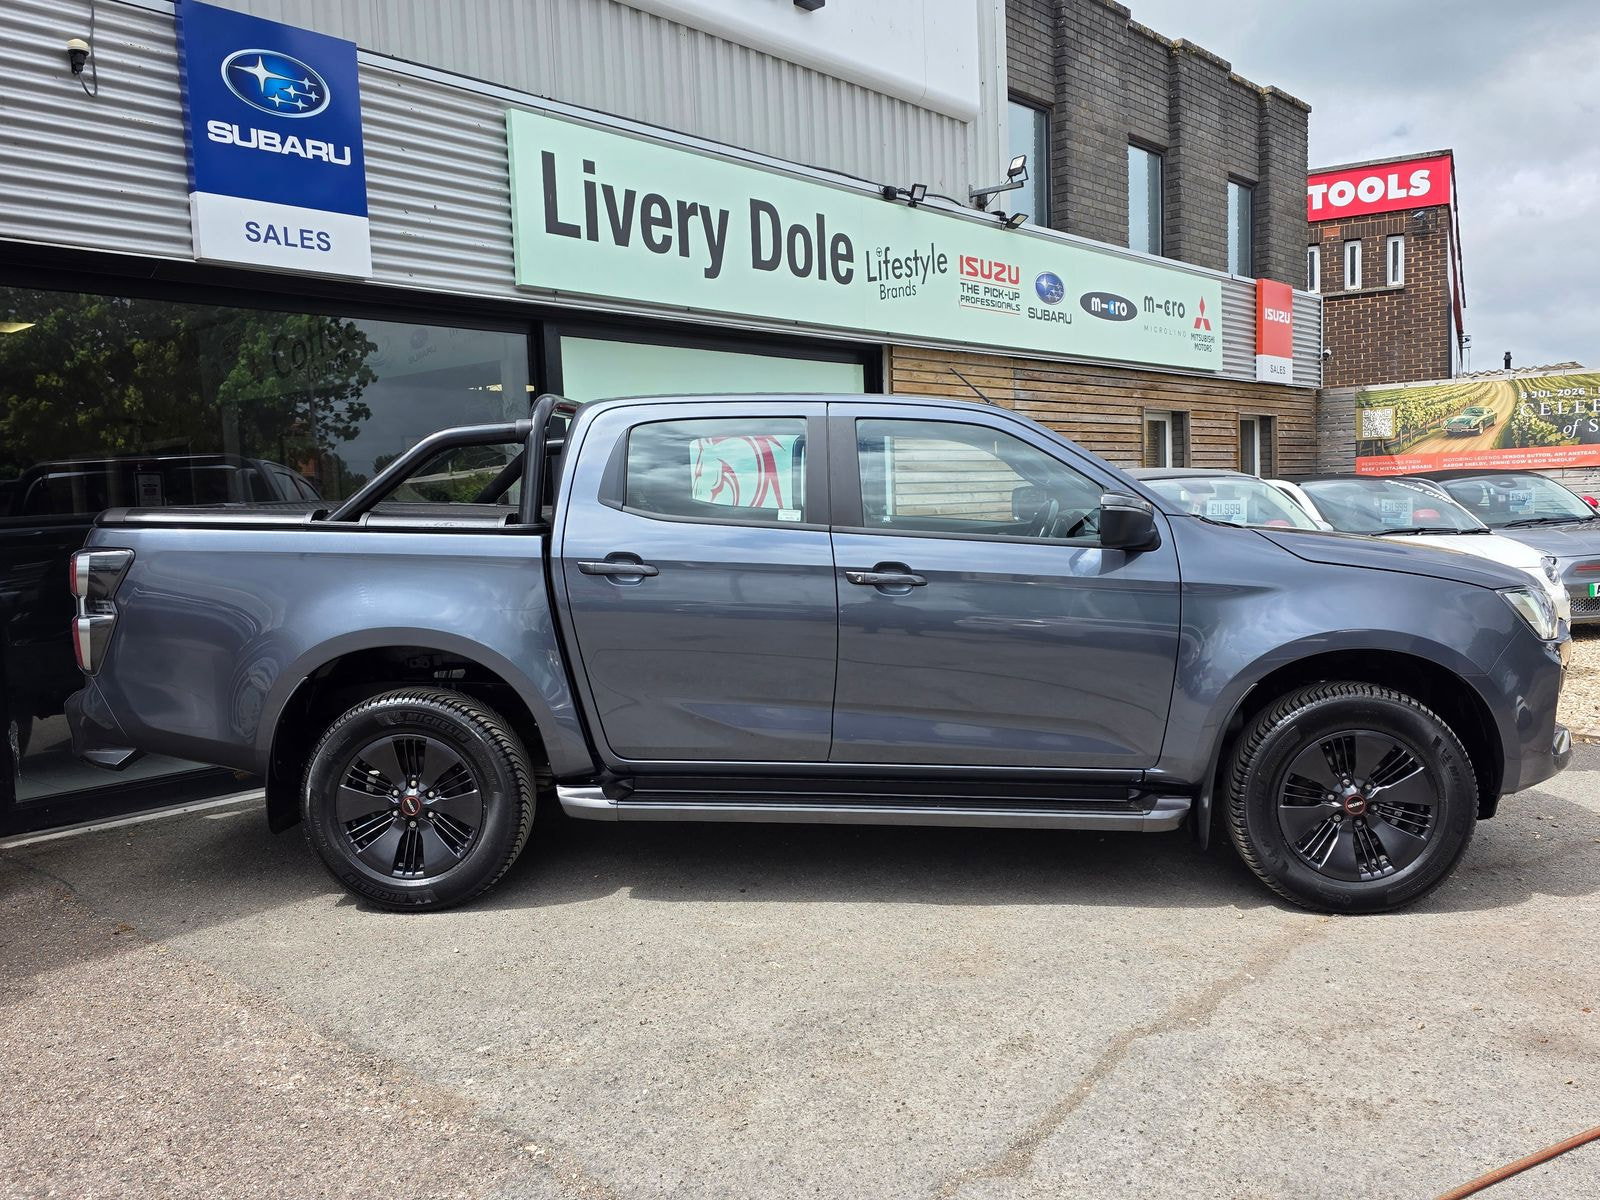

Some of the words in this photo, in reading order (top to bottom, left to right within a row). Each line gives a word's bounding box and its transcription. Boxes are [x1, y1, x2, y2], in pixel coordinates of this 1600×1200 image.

[207, 120, 351, 166] SUBARU
[1308, 169, 1431, 210] TOOLS
[541, 150, 730, 279] Livery
[750, 198, 854, 285] Dole
[245, 221, 332, 252] SALES
[865, 242, 948, 285] Lifestyle
[959, 254, 1020, 285] ISUZU
[879, 280, 917, 301] Brands
[960, 282, 980, 295] THE
[983, 286, 1020, 301] PICK-UP
[960, 296, 1021, 312] PROFESSIONALS
[1027, 307, 1073, 325] SUBARU
[1264, 307, 1291, 324] ISUZU
[1143, 324, 1187, 338] MICROLINO
[1190, 332, 1216, 344] MITSUBISHI
[1194, 342, 1213, 353] MOTORS
[1270, 364, 1287, 375] SALES
[1531, 389, 1553, 399] JUL
[1557, 387, 1586, 397] 2026
[1563, 418, 1583, 439] of
